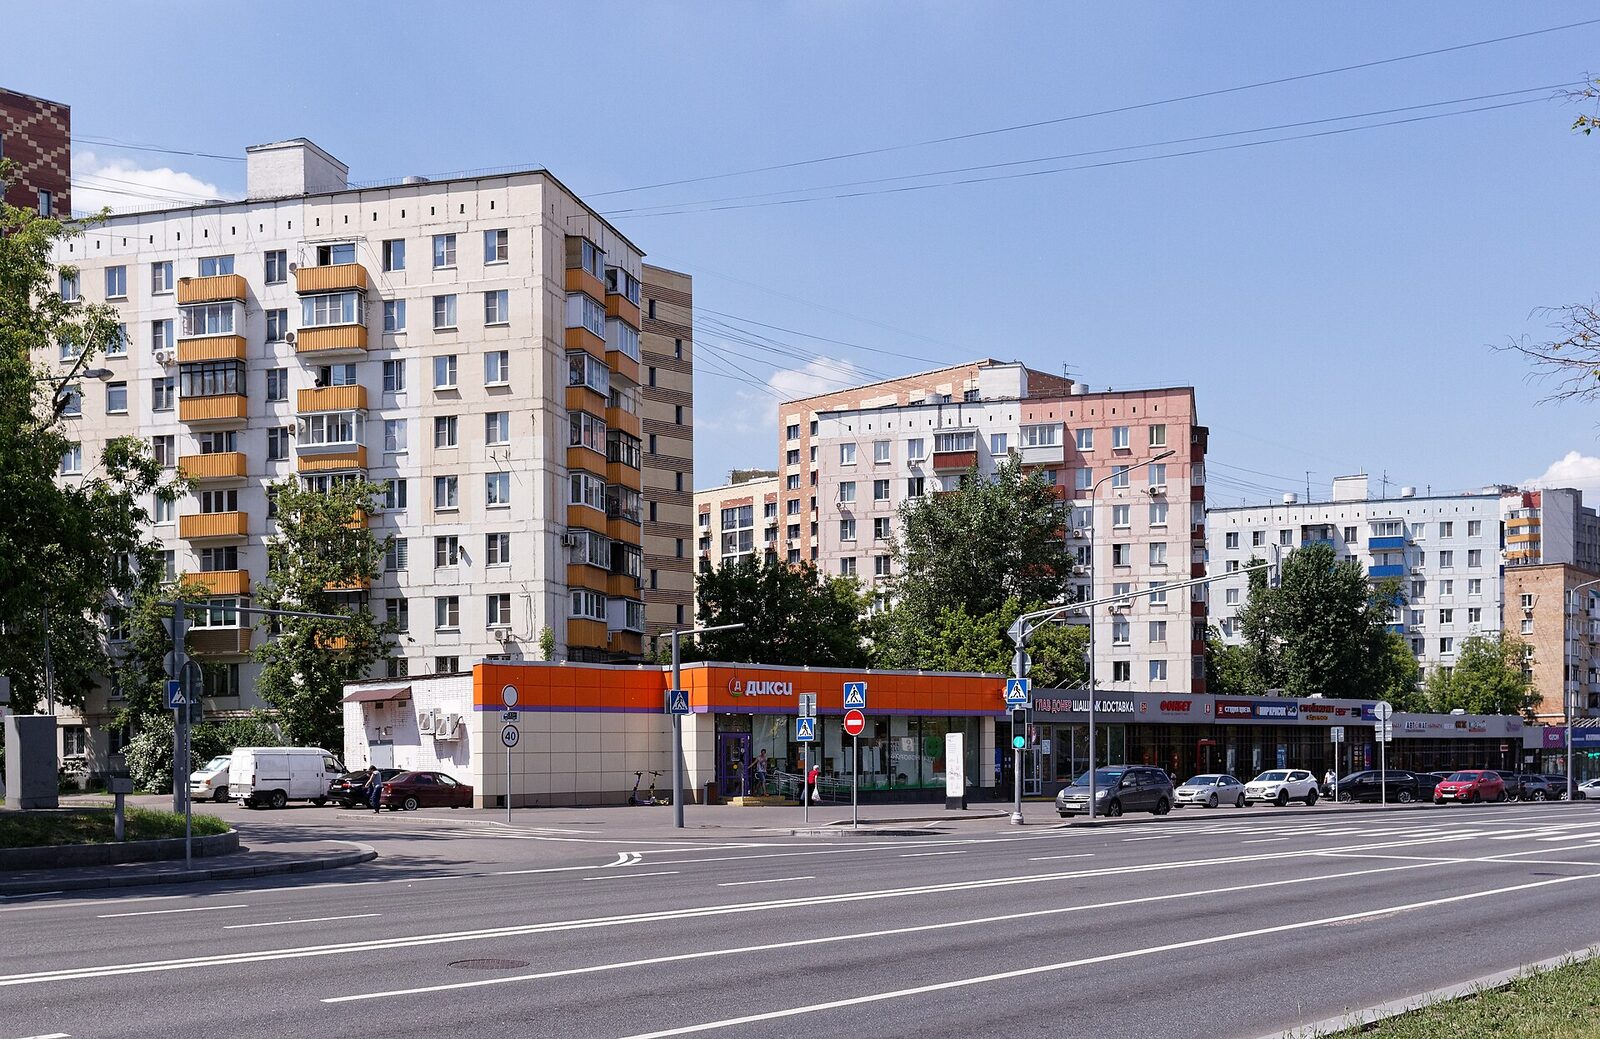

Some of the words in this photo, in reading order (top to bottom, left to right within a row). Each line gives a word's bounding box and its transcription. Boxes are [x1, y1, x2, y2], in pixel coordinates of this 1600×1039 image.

[1035, 699, 1051, 711] ГЛАВ
[1051, 700, 1072, 714] ДОНЕР
[1102, 700, 1135, 713] ДОСТАВКА
[505, 732, 516, 740] 40
